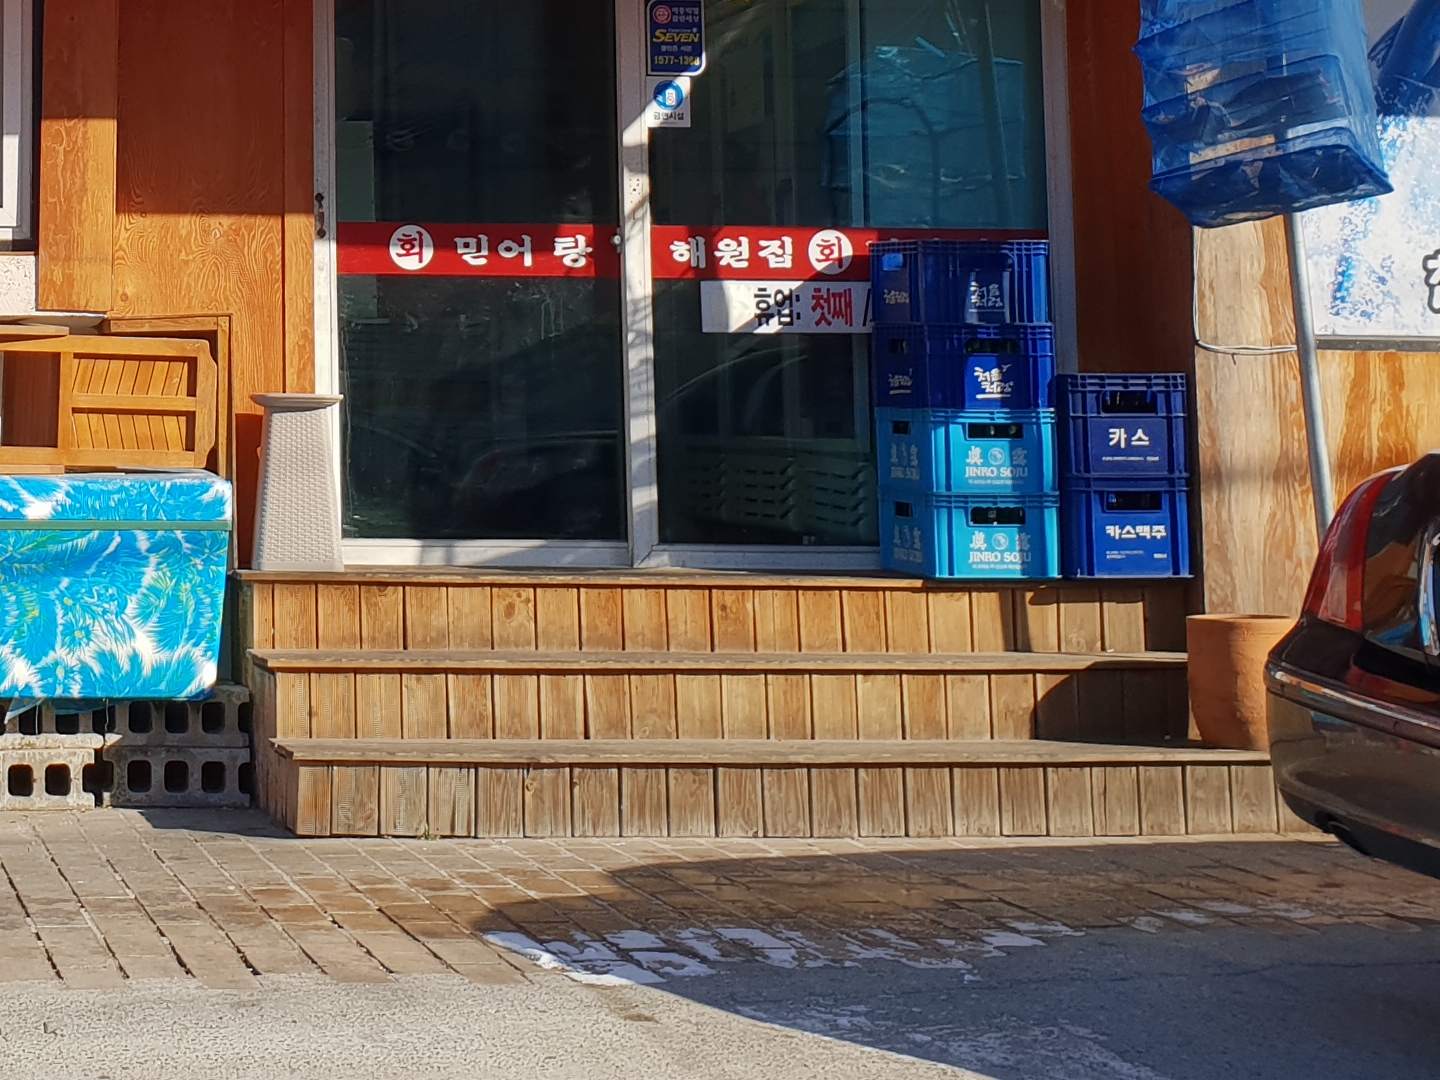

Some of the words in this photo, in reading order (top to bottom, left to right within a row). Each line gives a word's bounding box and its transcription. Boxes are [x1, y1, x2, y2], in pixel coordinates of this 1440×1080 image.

[395, 230, 424, 264] 회
[669, 235, 793, 269] 해원집
[814, 235, 845, 269] 회
[1108, 428, 1150, 448] 카스
[964, 466, 998, 478] JINRO
[1000, 466, 1029, 478] SOJU
[1105, 525, 1167, 540] 카스맥주
[968, 551, 1002, 564] JINRO
